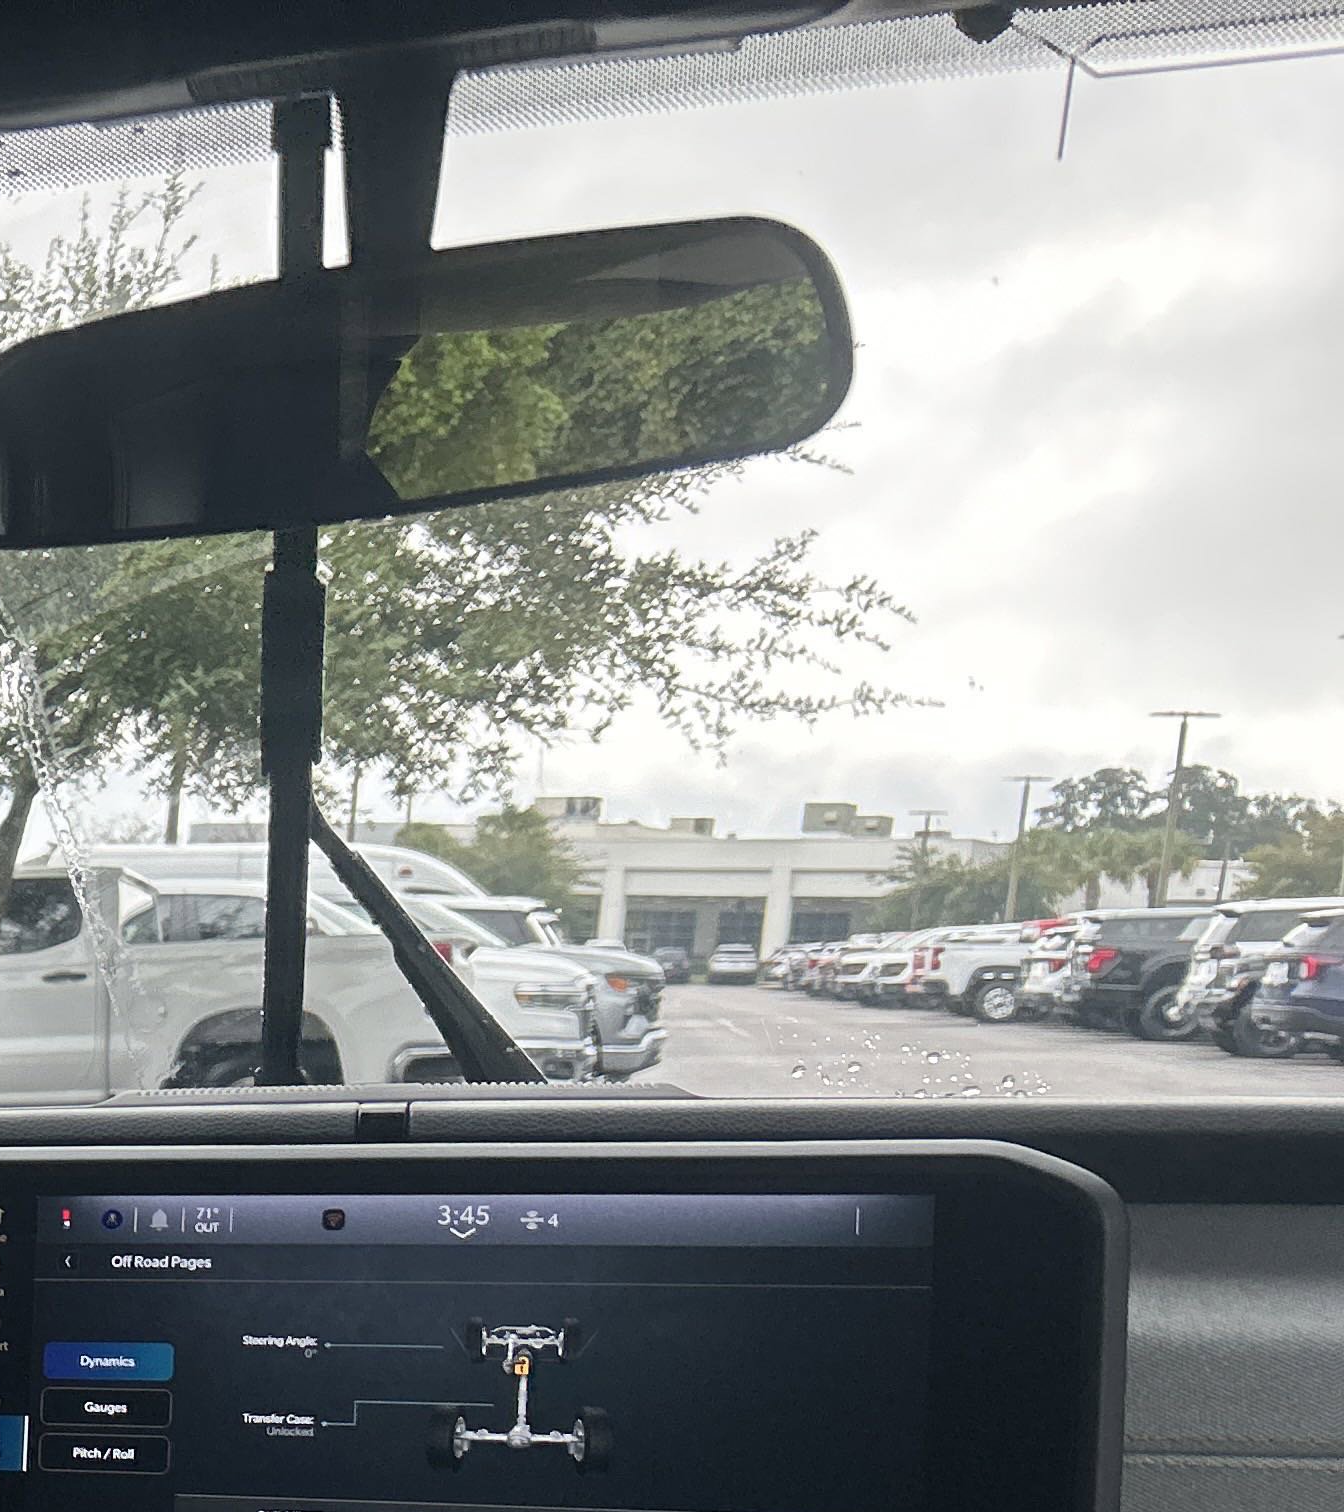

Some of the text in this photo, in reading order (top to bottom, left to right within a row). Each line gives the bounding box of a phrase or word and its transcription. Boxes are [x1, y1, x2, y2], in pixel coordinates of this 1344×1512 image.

[197, 1207, 220, 1219] 71°
[437, 1204, 490, 1226] 3:45
[547, 1213, 559, 1227] 4
[194, 1222, 220, 1233] OUT
[111, 1255, 213, 1271] Off Road Pages
[242, 1335, 318, 1348] Steering Angle:
[79, 1355, 136, 1369] Dynamics
[84, 1401, 128, 1415] Gauges
[242, 1413, 315, 1425] Transfer Case:
[266, 1426, 315, 1437] Unlocked
[72, 1446, 135, 1461] Pitch / Roll
